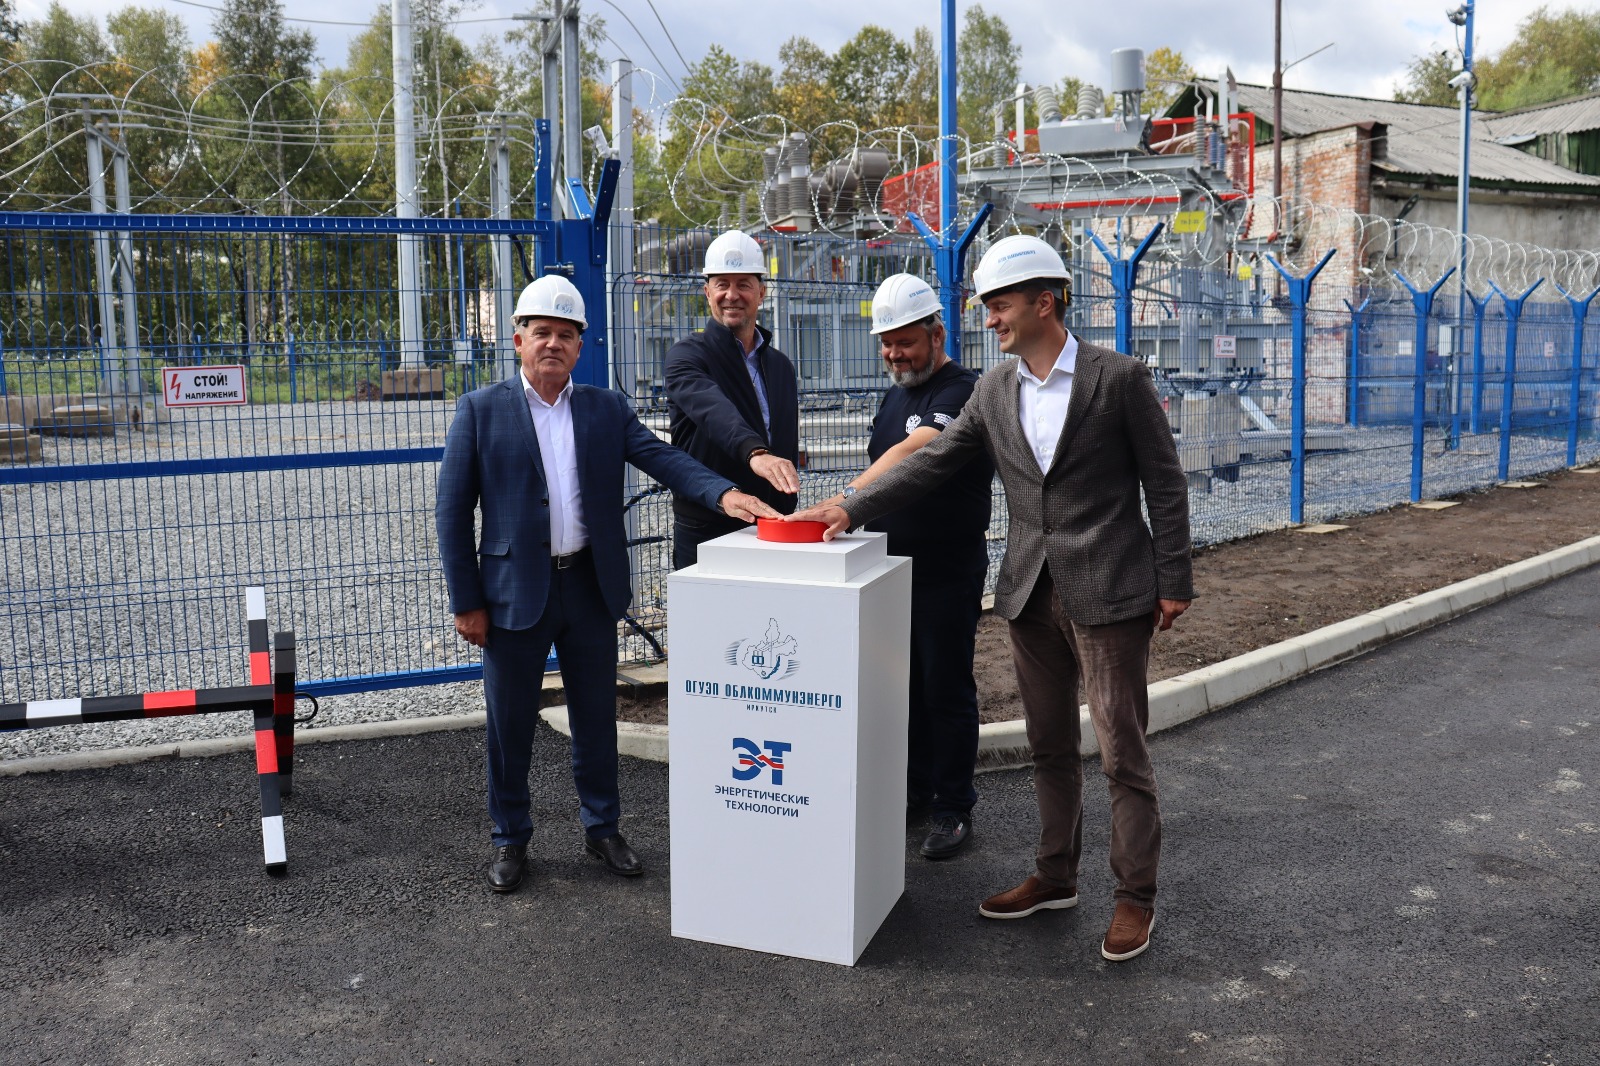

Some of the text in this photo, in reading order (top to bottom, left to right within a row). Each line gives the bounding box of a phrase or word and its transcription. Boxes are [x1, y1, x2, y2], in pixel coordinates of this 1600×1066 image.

[194, 372, 228, 387] СТОЙ!
[185, 391, 238, 399] НАПРЯЖЕНИЕ
[685, 679, 842, 709] ОГУЭП ОБЛКОММУНЭНЕРГО
[746, 704, 777, 714] ИРКУТСК
[714, 784, 810, 806] ЭНЕРГЕТИЧЕСКИЕ
[725, 799, 799, 818] ТЕХНОЛОГИИ
